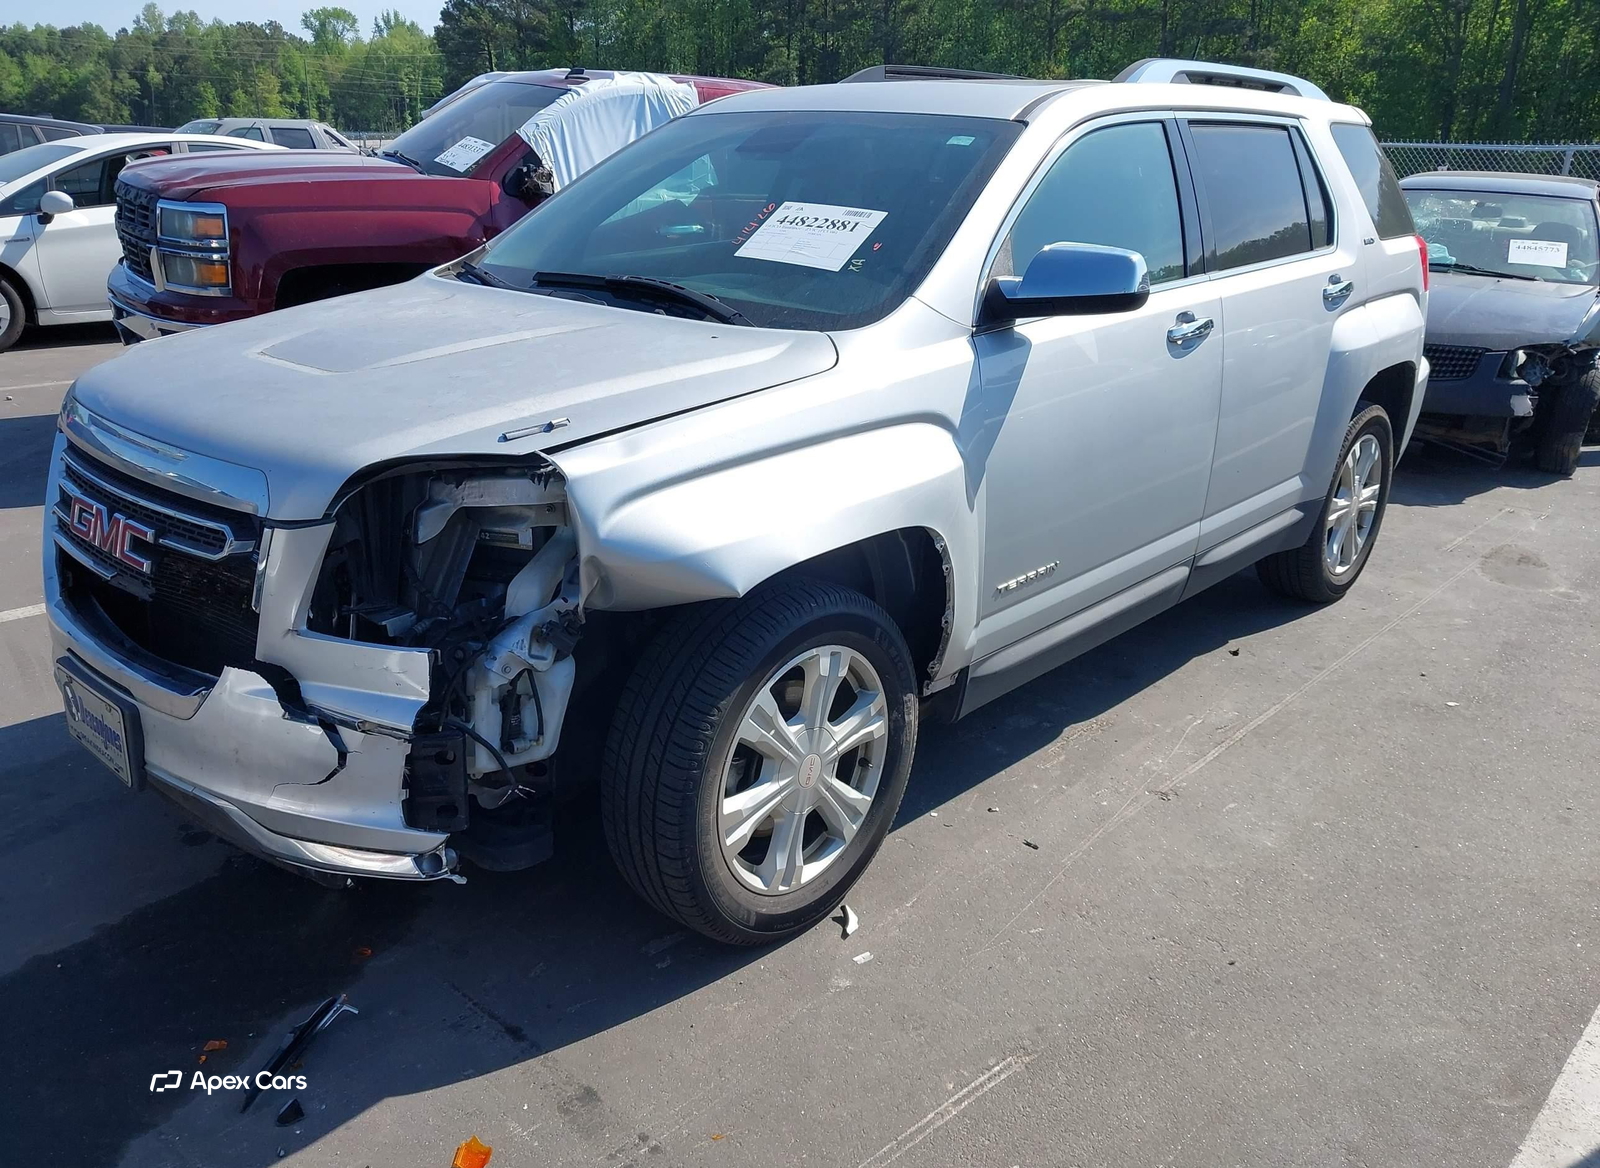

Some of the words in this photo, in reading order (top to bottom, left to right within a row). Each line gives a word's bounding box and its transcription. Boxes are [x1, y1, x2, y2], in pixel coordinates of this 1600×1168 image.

[776, 214, 861, 233] 44822881
[69, 495, 156, 574] GMC
[994, 560, 1060, 594] TERRAIN
